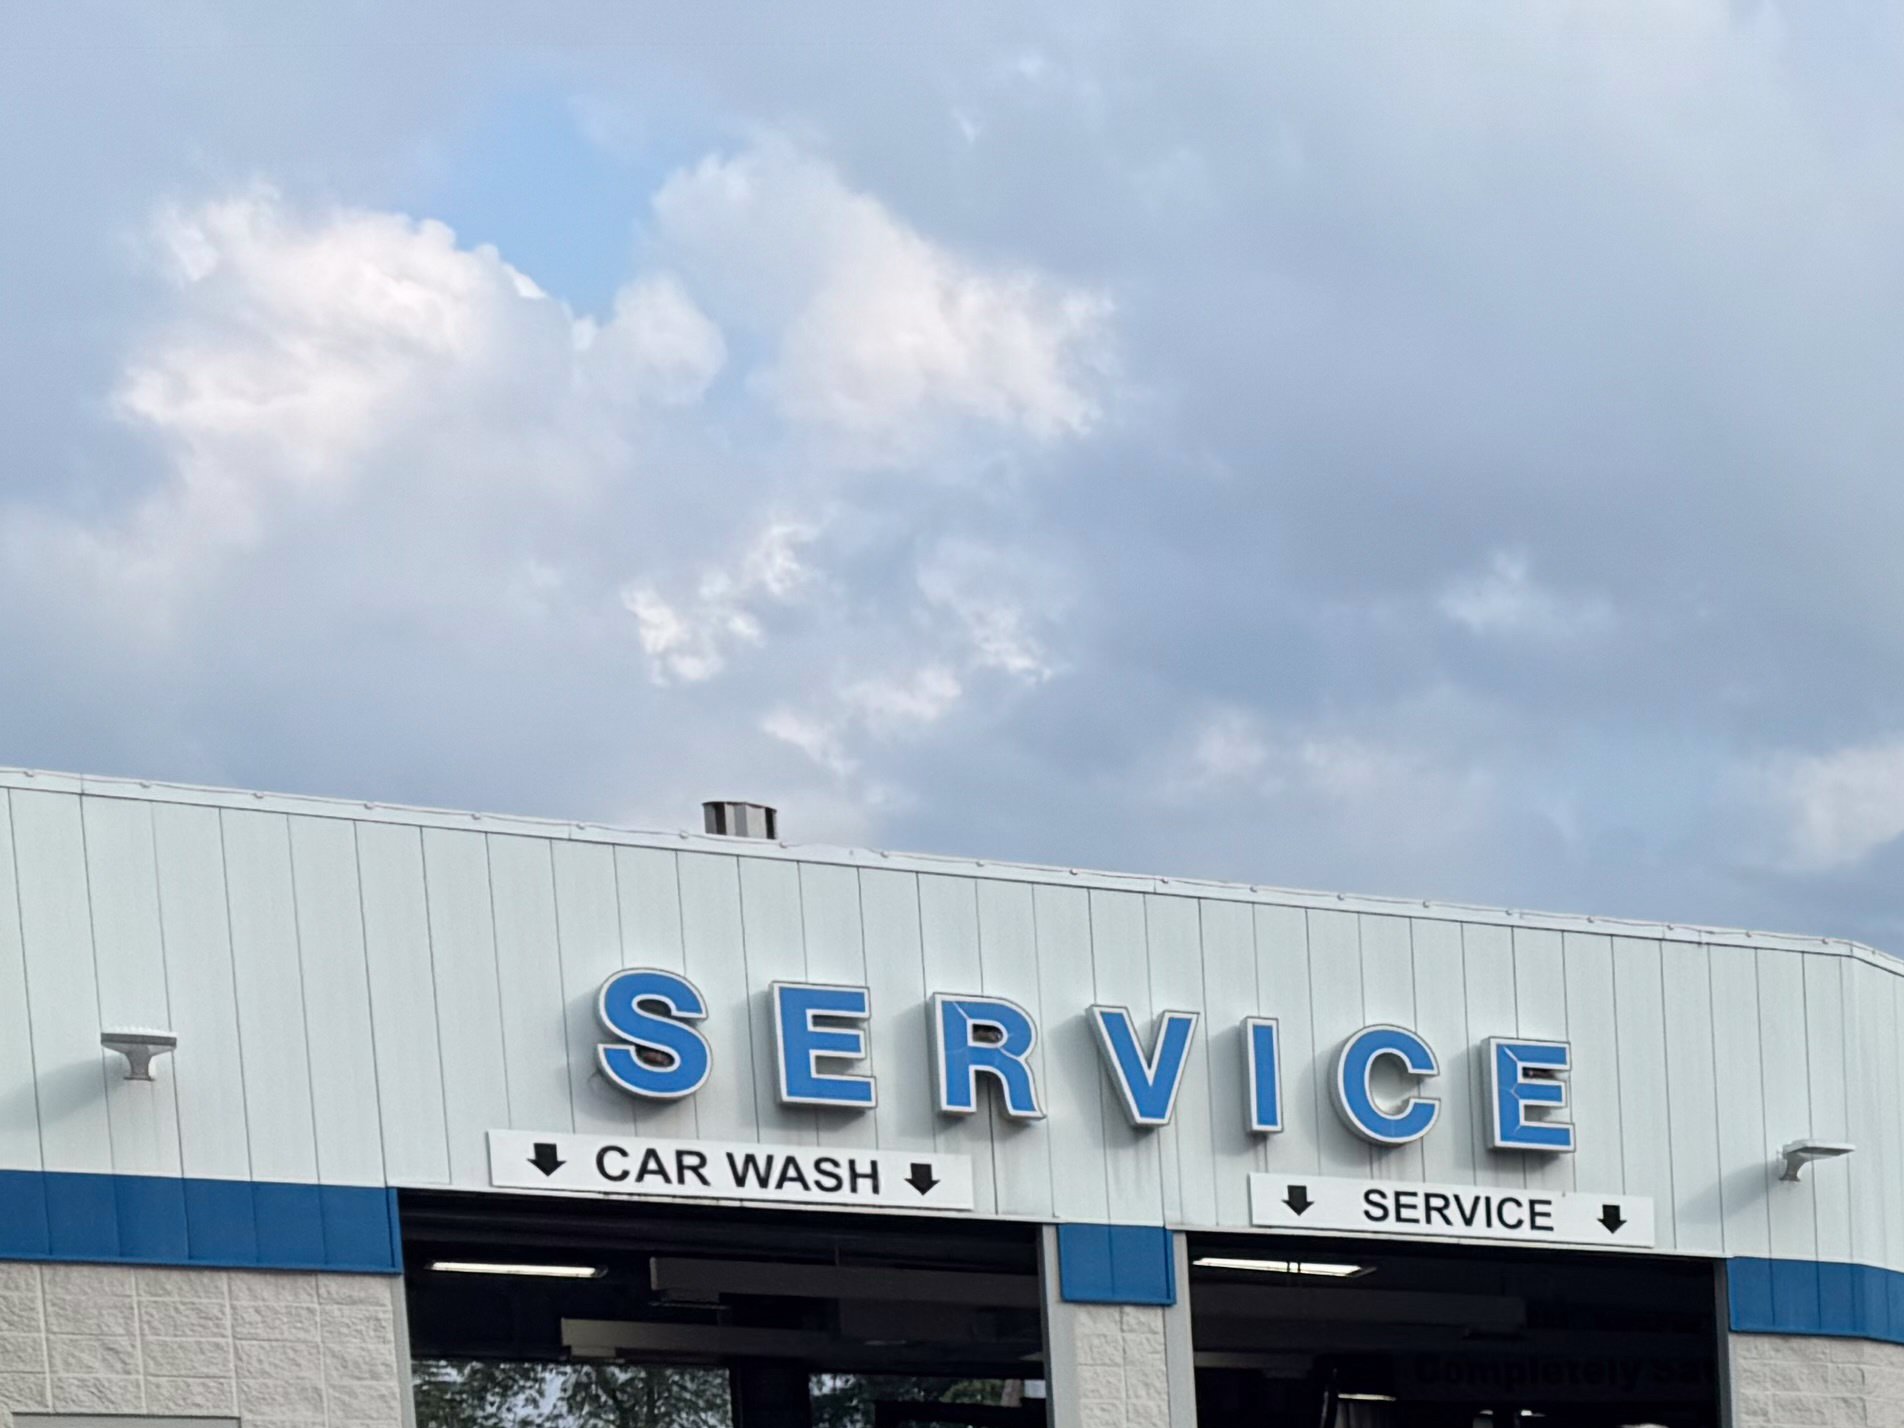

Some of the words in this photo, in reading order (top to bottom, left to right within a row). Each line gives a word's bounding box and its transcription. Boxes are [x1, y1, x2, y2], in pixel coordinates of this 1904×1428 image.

[596, 968, 1576, 1153] SERVICE
[596, 1145, 711, 1187] CAR
[726, 1151, 880, 1195] WASH
[1363, 1188, 1554, 1232] SERVICE
